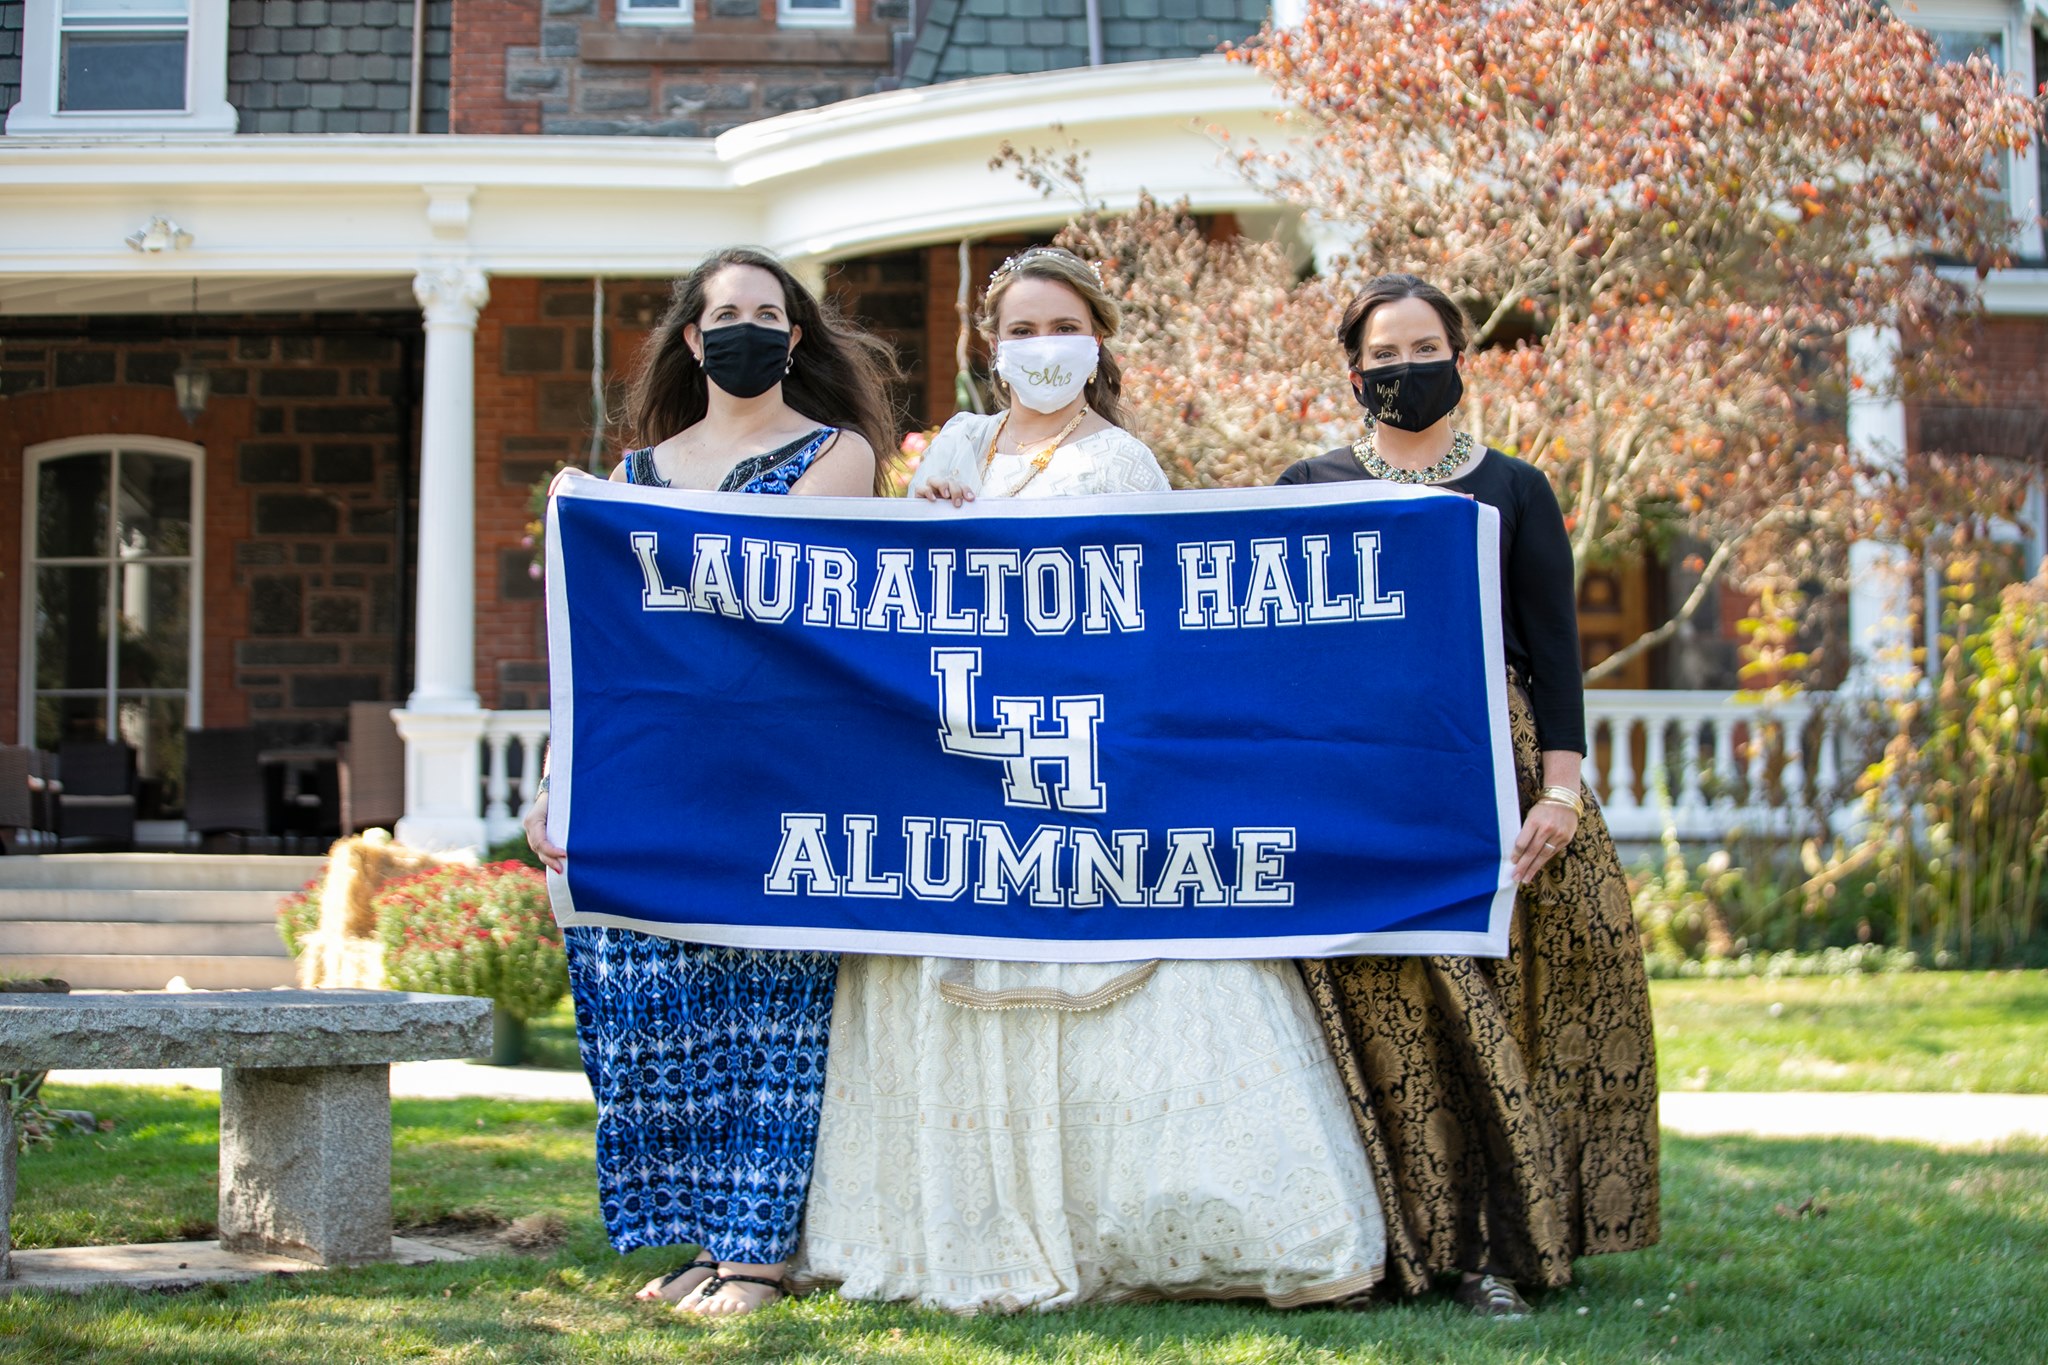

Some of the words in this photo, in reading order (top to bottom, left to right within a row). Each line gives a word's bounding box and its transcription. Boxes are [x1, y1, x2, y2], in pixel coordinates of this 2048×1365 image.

[1021, 364, 1072, 387] Mrs
[1376, 379, 1400, 398] Maid
[631, 532, 1145, 636] LAURALTON
[1177, 531, 1405, 630] HALL
[931, 646, 1107, 813] LH
[764, 812, 1297, 909] ALUMNAE
